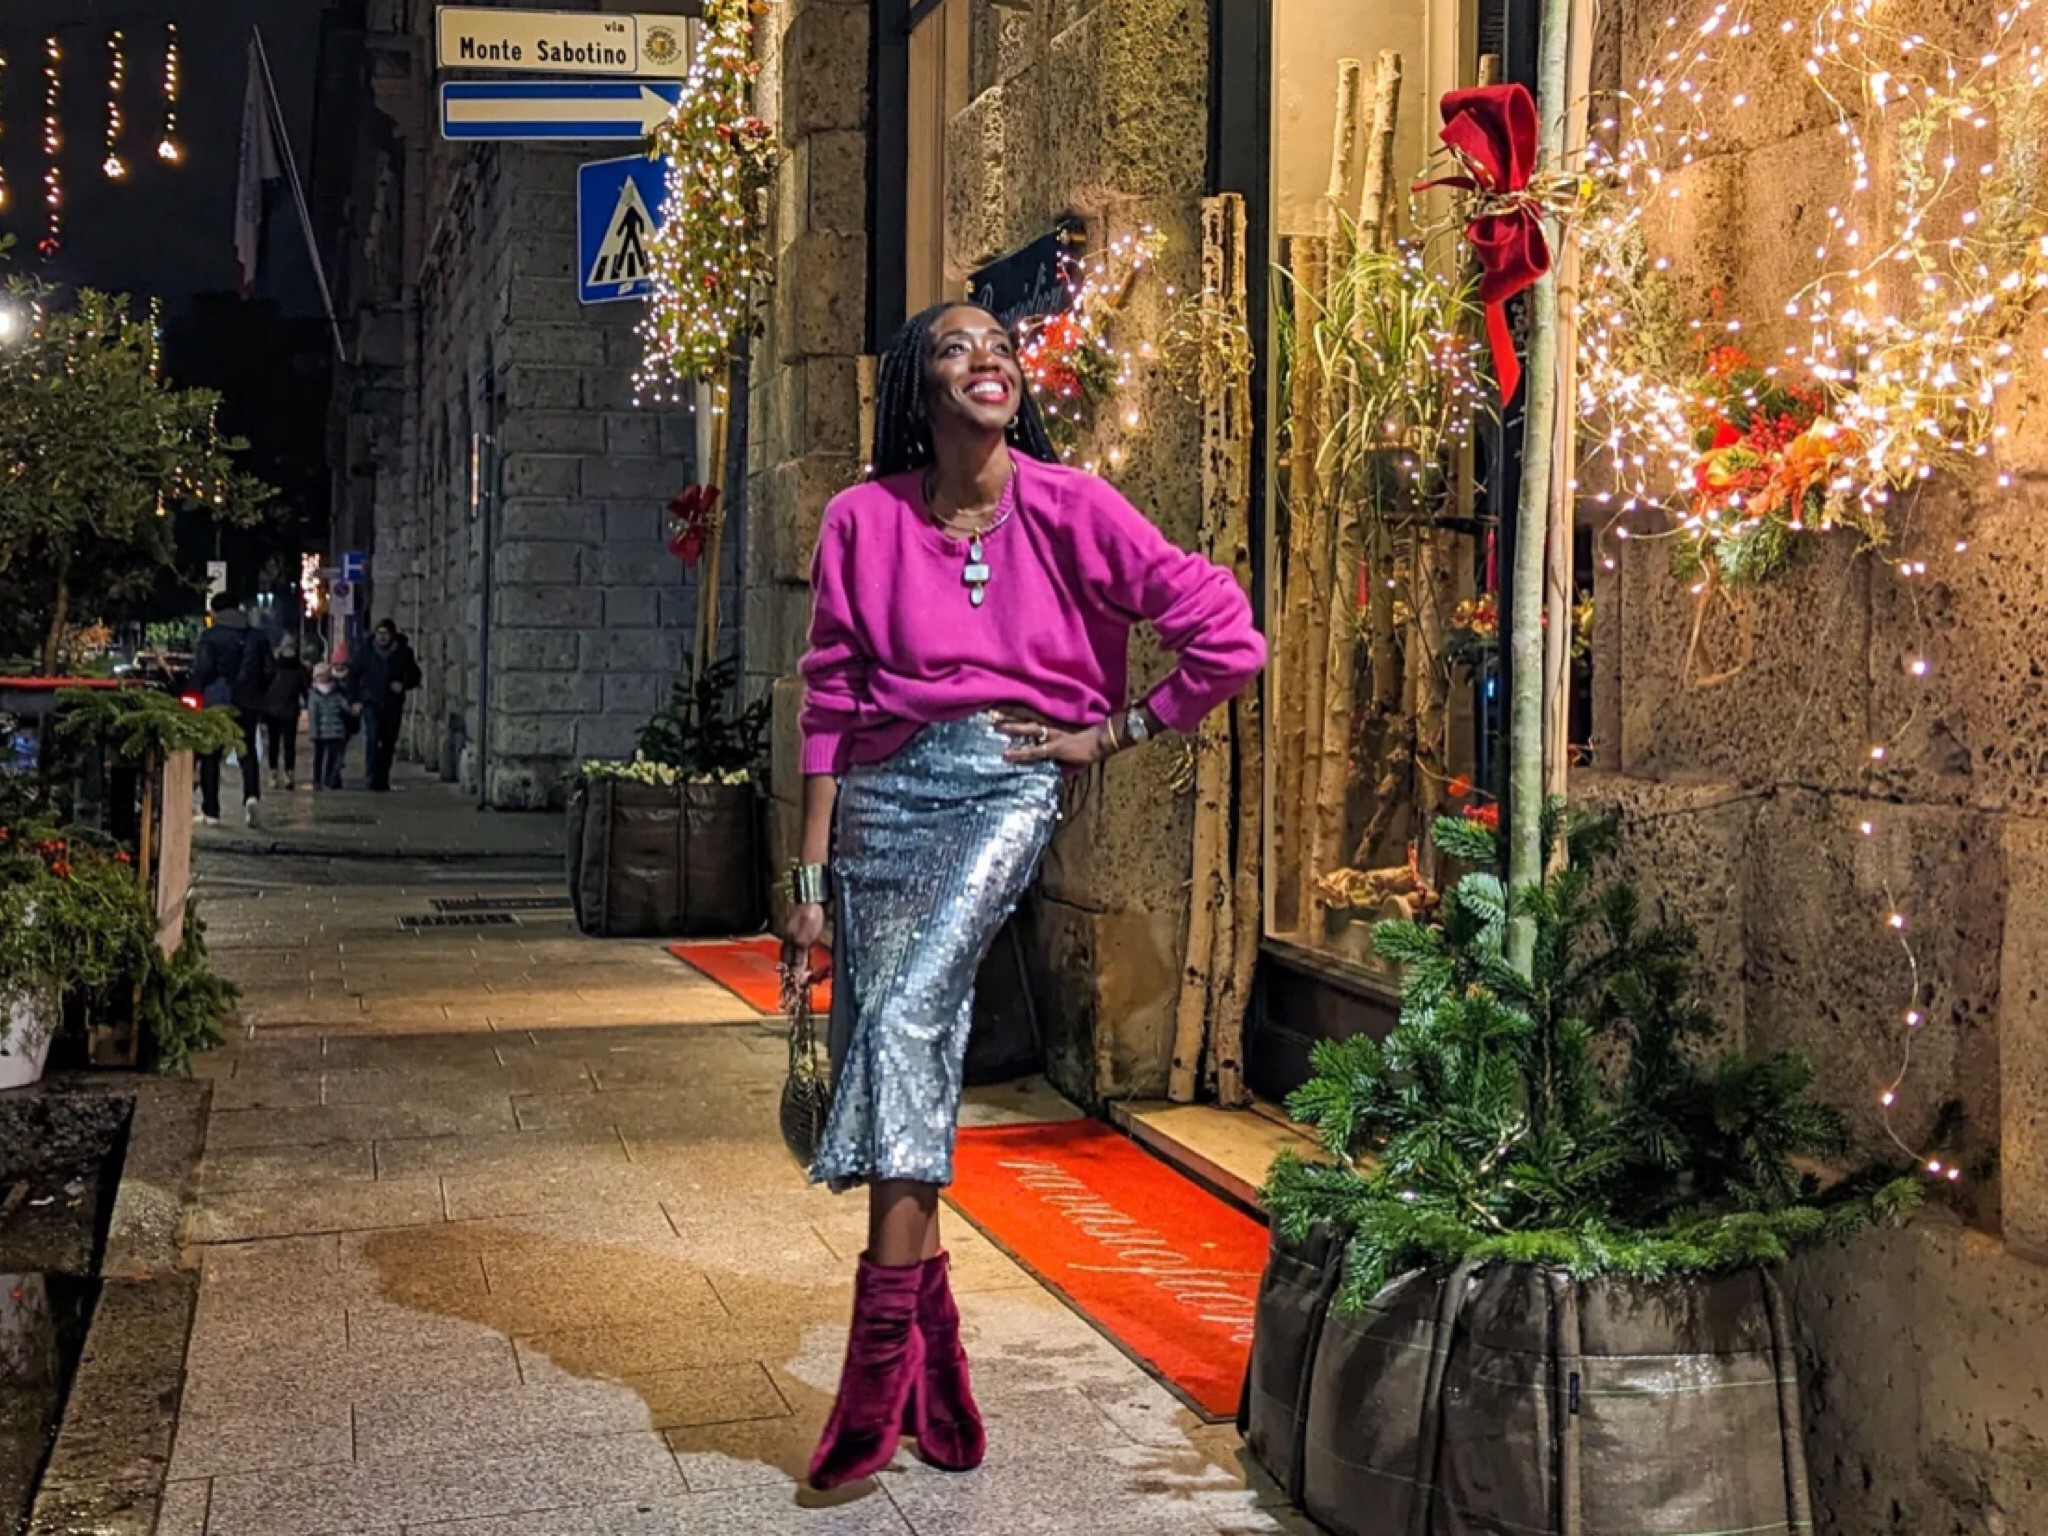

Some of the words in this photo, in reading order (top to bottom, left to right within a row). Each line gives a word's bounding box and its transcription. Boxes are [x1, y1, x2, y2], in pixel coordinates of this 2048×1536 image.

[604, 21, 625, 33] via
[460, 36, 522, 61] Monte
[537, 39, 627, 65] Sabotino
